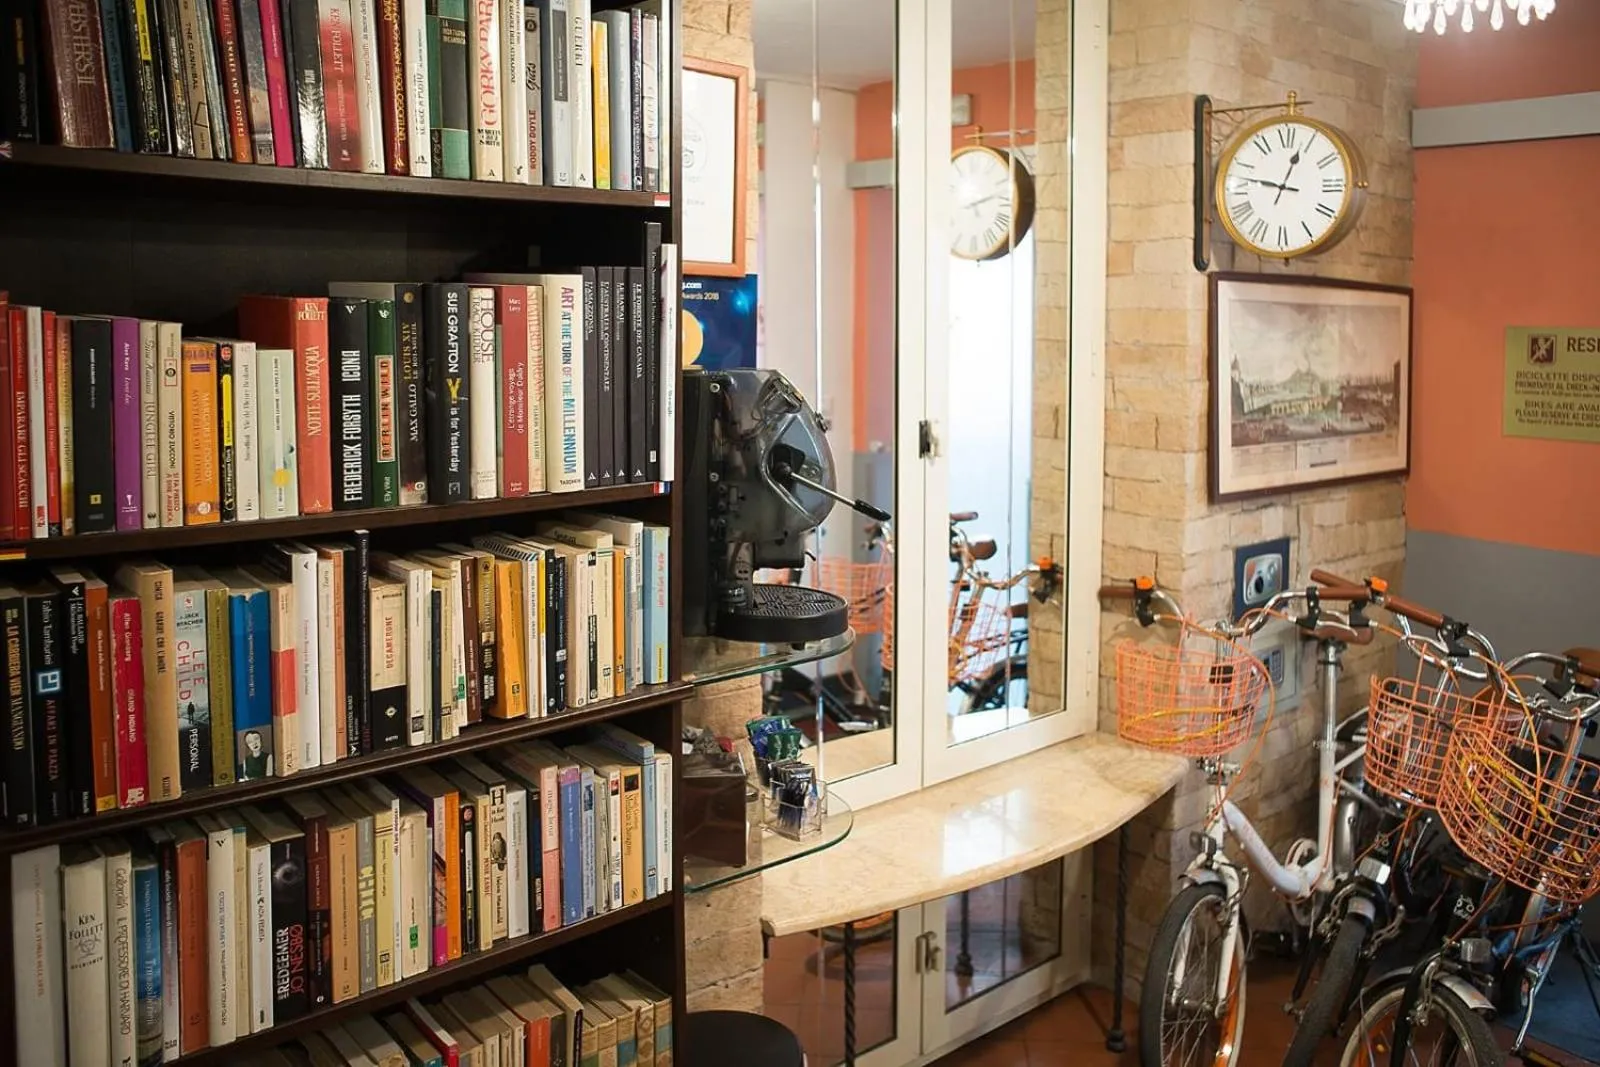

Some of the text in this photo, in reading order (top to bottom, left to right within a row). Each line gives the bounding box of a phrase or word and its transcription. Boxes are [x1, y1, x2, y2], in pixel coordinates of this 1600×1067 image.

[187, 43, 200, 91] CANNIBAL
[226, 41, 236, 73] SNAKES
[331, 29, 344, 73] FOLLETT
[231, 76, 240, 95] AND
[478, 46, 498, 127] GORKY
[233, 98, 245, 137] LADDERS
[528, 109, 538, 170] RODDY DOYLE
[587, 281, 596, 335] L'AMAZZONIA
[602, 281, 610, 332] L'AUSTRALIA
[618, 282, 626, 292] LE
[447, 291, 460, 373] SUE GRAFTON
[472, 296, 481, 365] TRACY KIDDER
[480, 296, 496, 365] HOUSE
[527, 290, 544, 352] SHATTERED
[635, 283, 643, 379] LE FORESTE DEL CANADA
[401, 322, 412, 380] LOUIS XIV
[602, 332, 611, 393] CONTINENTALE
[304, 345, 325, 438] NOTTE SULL'ACQUA
[530, 354, 545, 403] DREAMS
[560, 287, 577, 475] ART AT THE TURN OF THE MILLENNIUM
[15, 391, 28, 443] IMPARARE
[340, 349, 363, 502] FREDERICK FORSYTH ICONA
[379, 360, 392, 457] BERLIN WILD
[407, 384, 419, 442] MAX GALLO
[446, 377, 463, 473] Y is for Yesterday
[516, 389, 525, 435] de Monsieur
[17, 444, 28, 464] GLI
[168, 410, 177, 470] VITTORIO ZUCCONI
[18, 464, 30, 509] SCACCHI
[145, 452, 158, 480] GIRL
[6, 625, 18, 637] LA
[384, 616, 394, 669] DECAMERONE
[7, 637, 20, 677] CARRIERA
[177, 640, 193, 701] CHILD
[192, 650, 206, 686] LEE
[48, 748, 59, 782] PIAZZA
[188, 728, 200, 773] PERSONAL
[69, 923, 105, 941] FOLLETT
[78, 912, 97, 926] KEN
[113, 924, 131, 981] PROFESSORE
[276, 926, 290, 994] REDEEMER
[119, 980, 130, 990] DI
[290, 976, 305, 994] JO
[119, 991, 132, 1036] HARVARD
